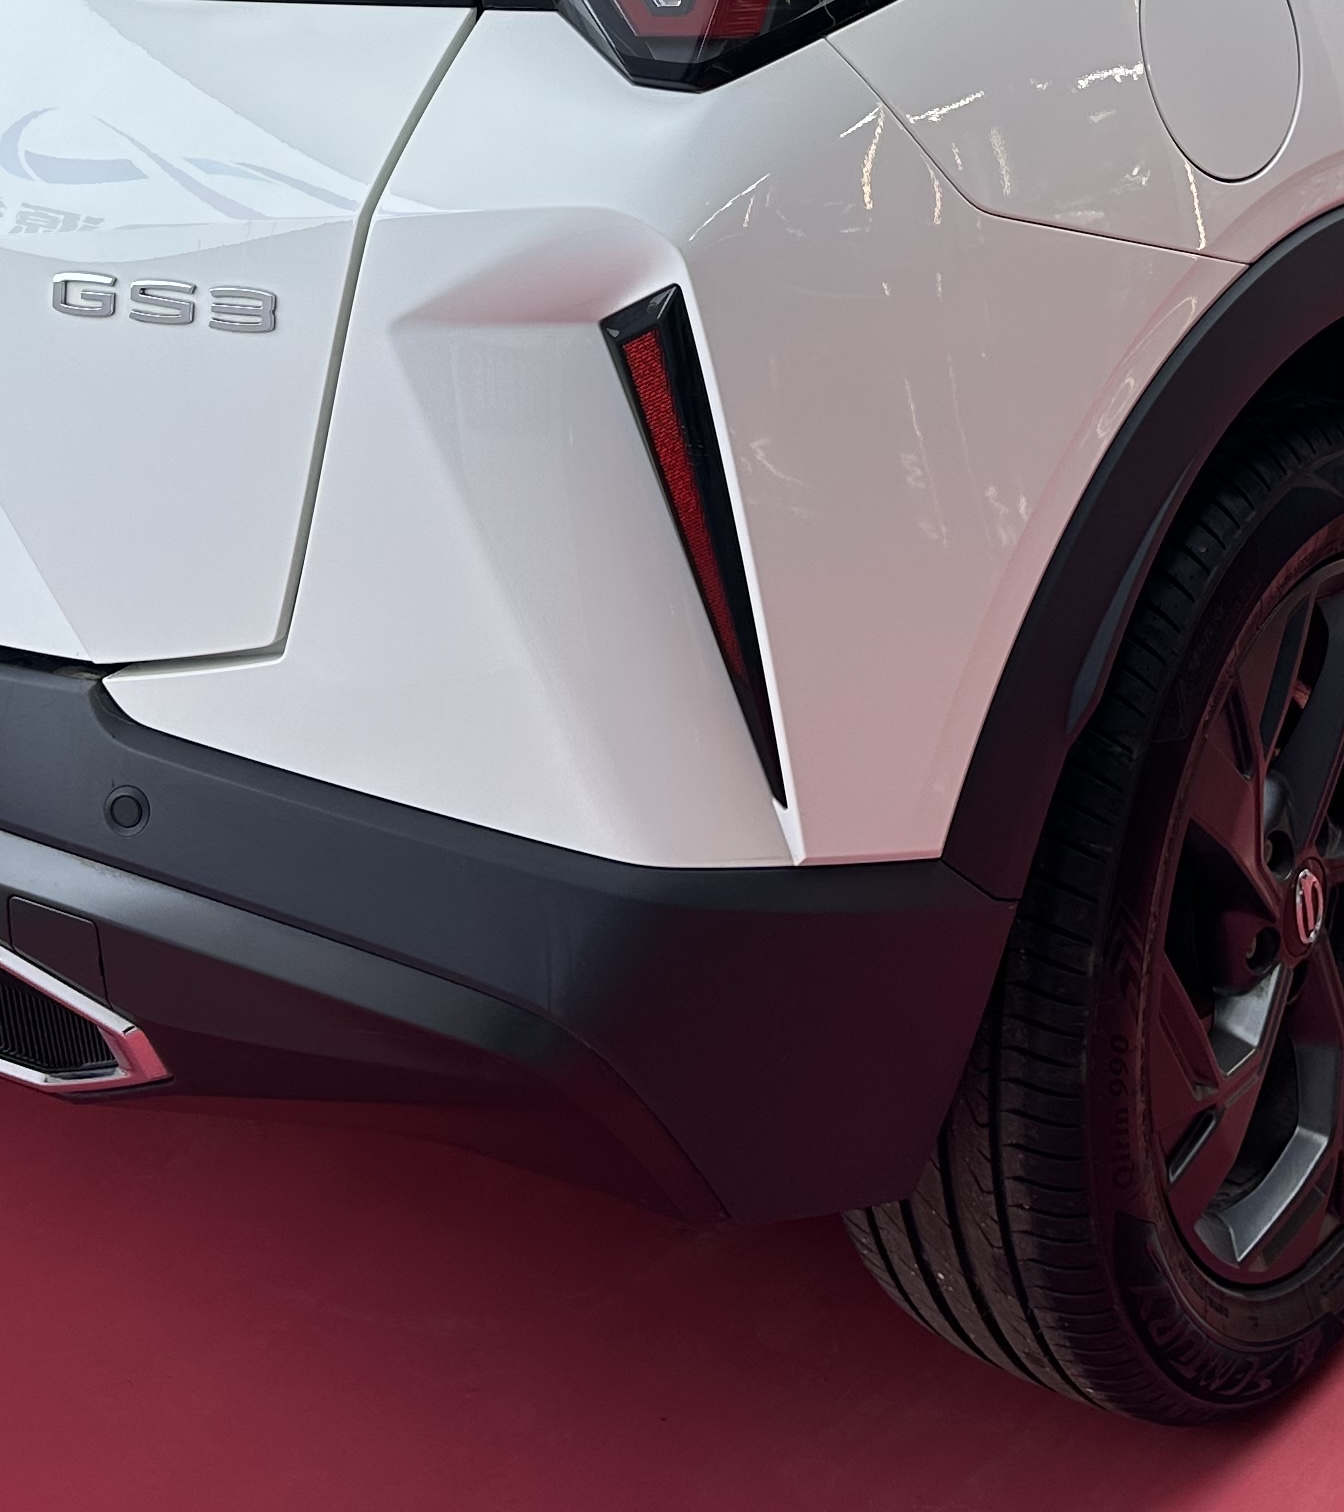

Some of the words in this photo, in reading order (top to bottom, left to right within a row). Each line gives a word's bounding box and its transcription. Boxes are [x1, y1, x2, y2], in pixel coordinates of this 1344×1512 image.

[52, 271, 277, 334] GS3
[1109, 1034, 1129, 1097] 990
[1110, 1107, 1134, 1189] Qirin
